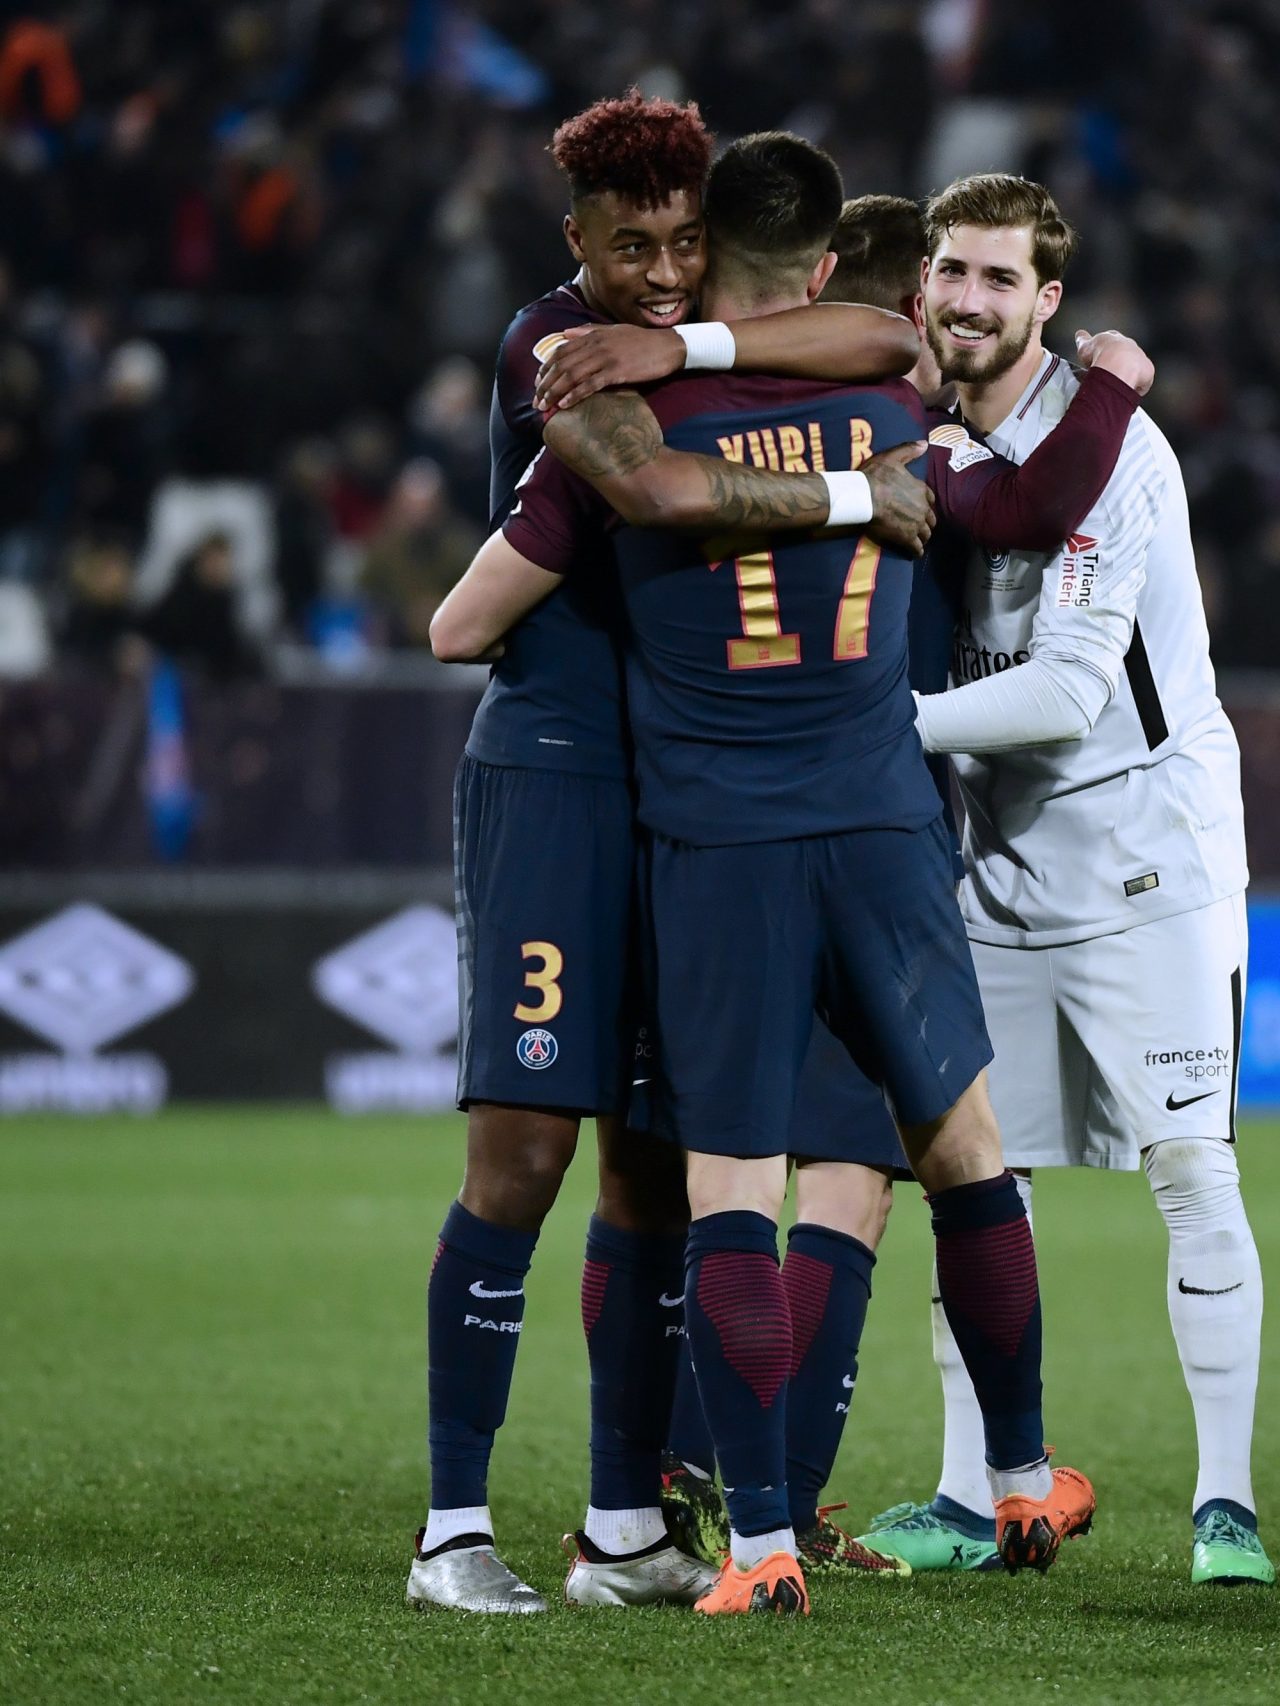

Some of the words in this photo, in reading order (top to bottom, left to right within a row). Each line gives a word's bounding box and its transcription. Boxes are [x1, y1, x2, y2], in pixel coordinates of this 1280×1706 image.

[512, 940, 564, 1024] 3
[524, 1031, 551, 1043] PARIS
[1185, 1063, 1229, 1082] sport
